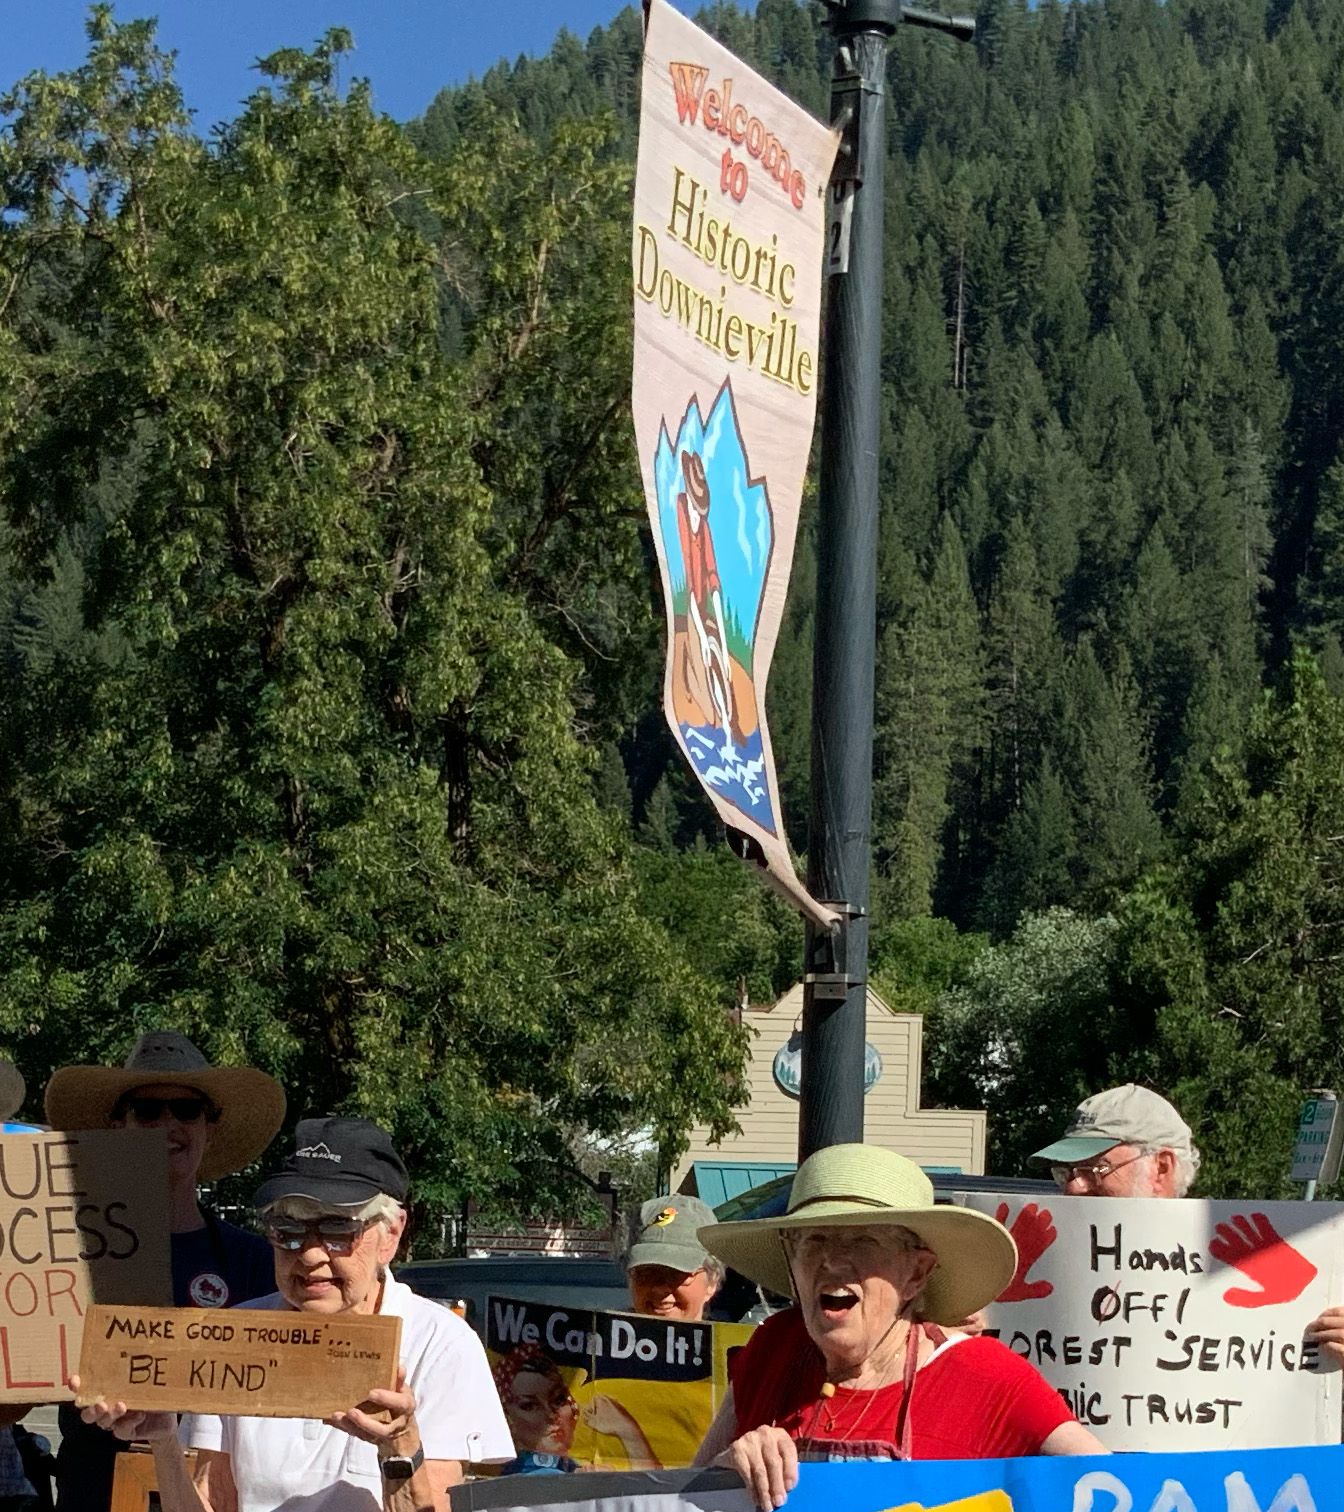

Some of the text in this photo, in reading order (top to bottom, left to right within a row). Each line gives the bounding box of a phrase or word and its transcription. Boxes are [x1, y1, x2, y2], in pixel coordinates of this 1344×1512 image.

[669, 61, 806, 209] Welcome
[720, 148, 749, 203] to
[667, 166, 796, 308] Historic
[637, 225, 814, 395] Downieville
[1090, 1223, 1205, 1273] Hands
[186, 1322, 235, 1342] GOOD
[493, 1302, 704, 1367] We Can Do It!
[189, 1359, 279, 1392] KIND"
[1121, 1394, 1243, 1429] TRUST
